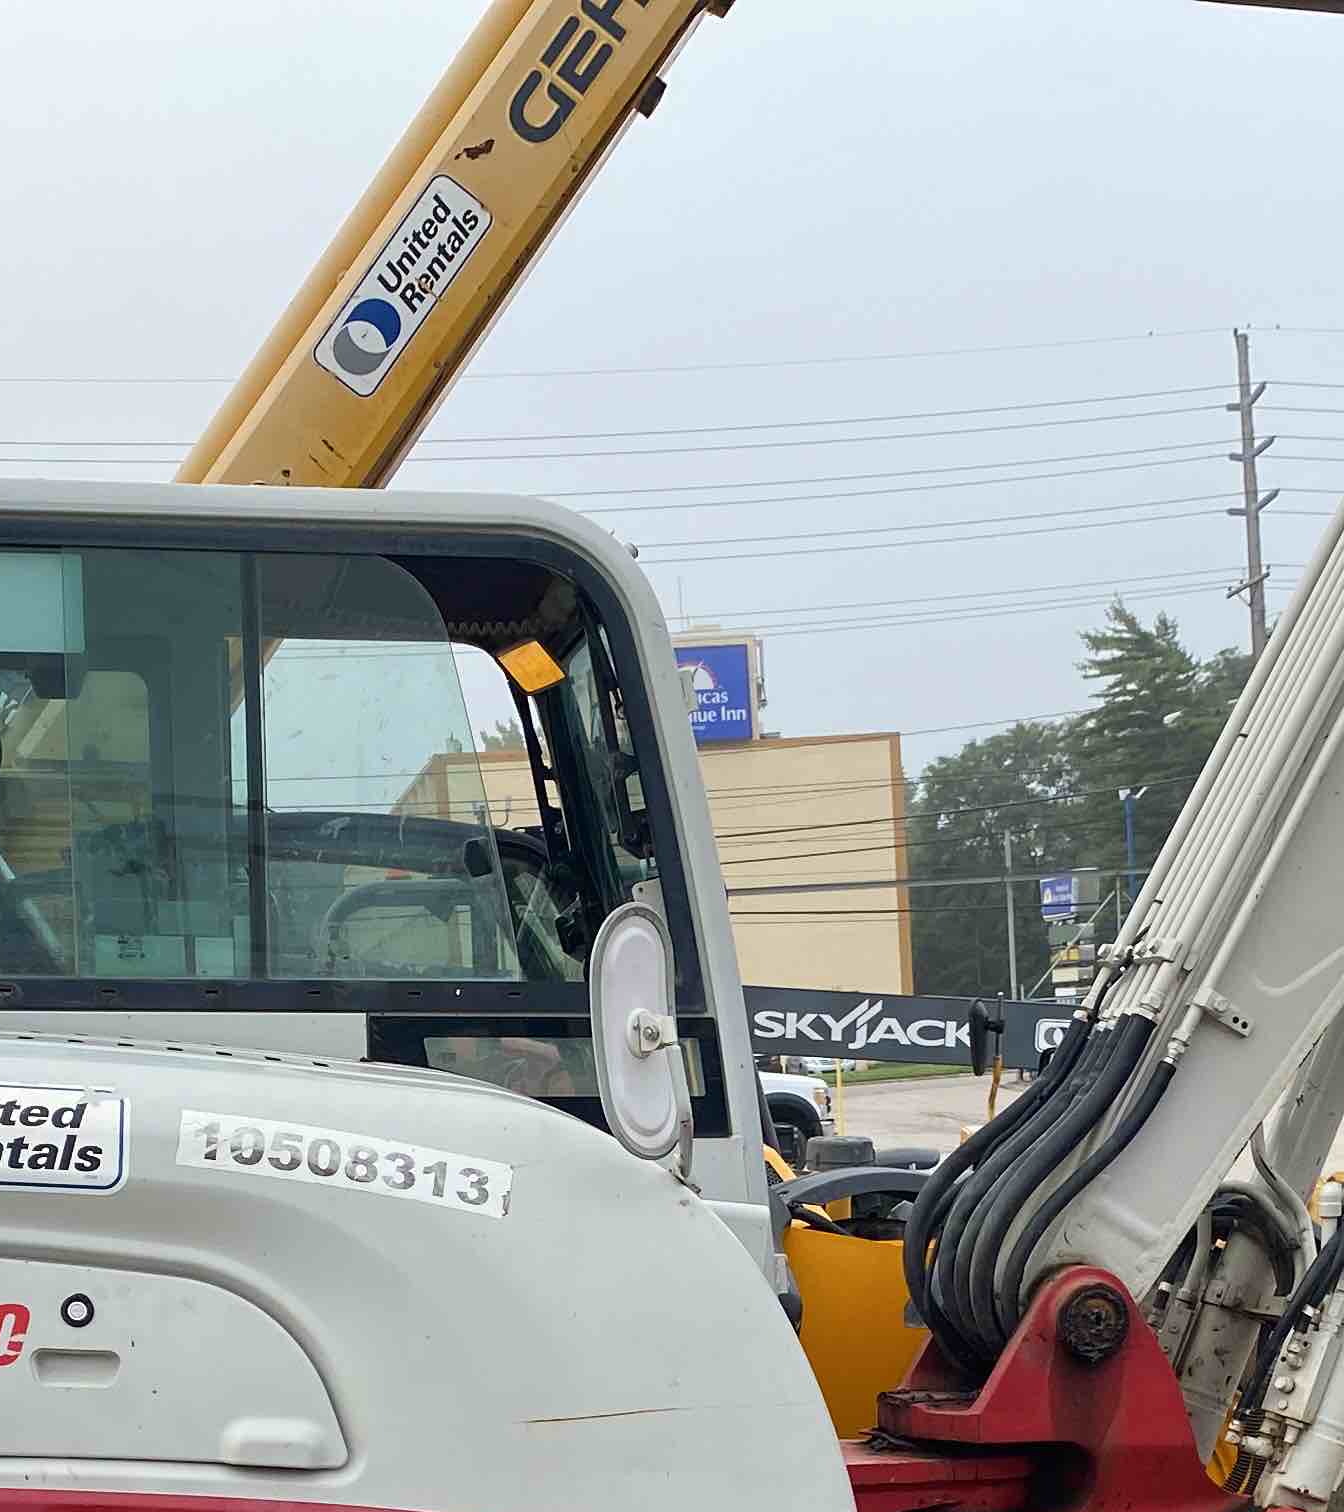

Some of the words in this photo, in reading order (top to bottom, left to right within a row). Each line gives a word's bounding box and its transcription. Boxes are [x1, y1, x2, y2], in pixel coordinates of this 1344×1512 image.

[377, 193, 451, 293] United
[399, 209, 479, 314] Rentals
[720, 705, 747, 721] Inn
[752, 999, 972, 1050] SKYJACK
[196, 1119, 491, 1206] 10508313
